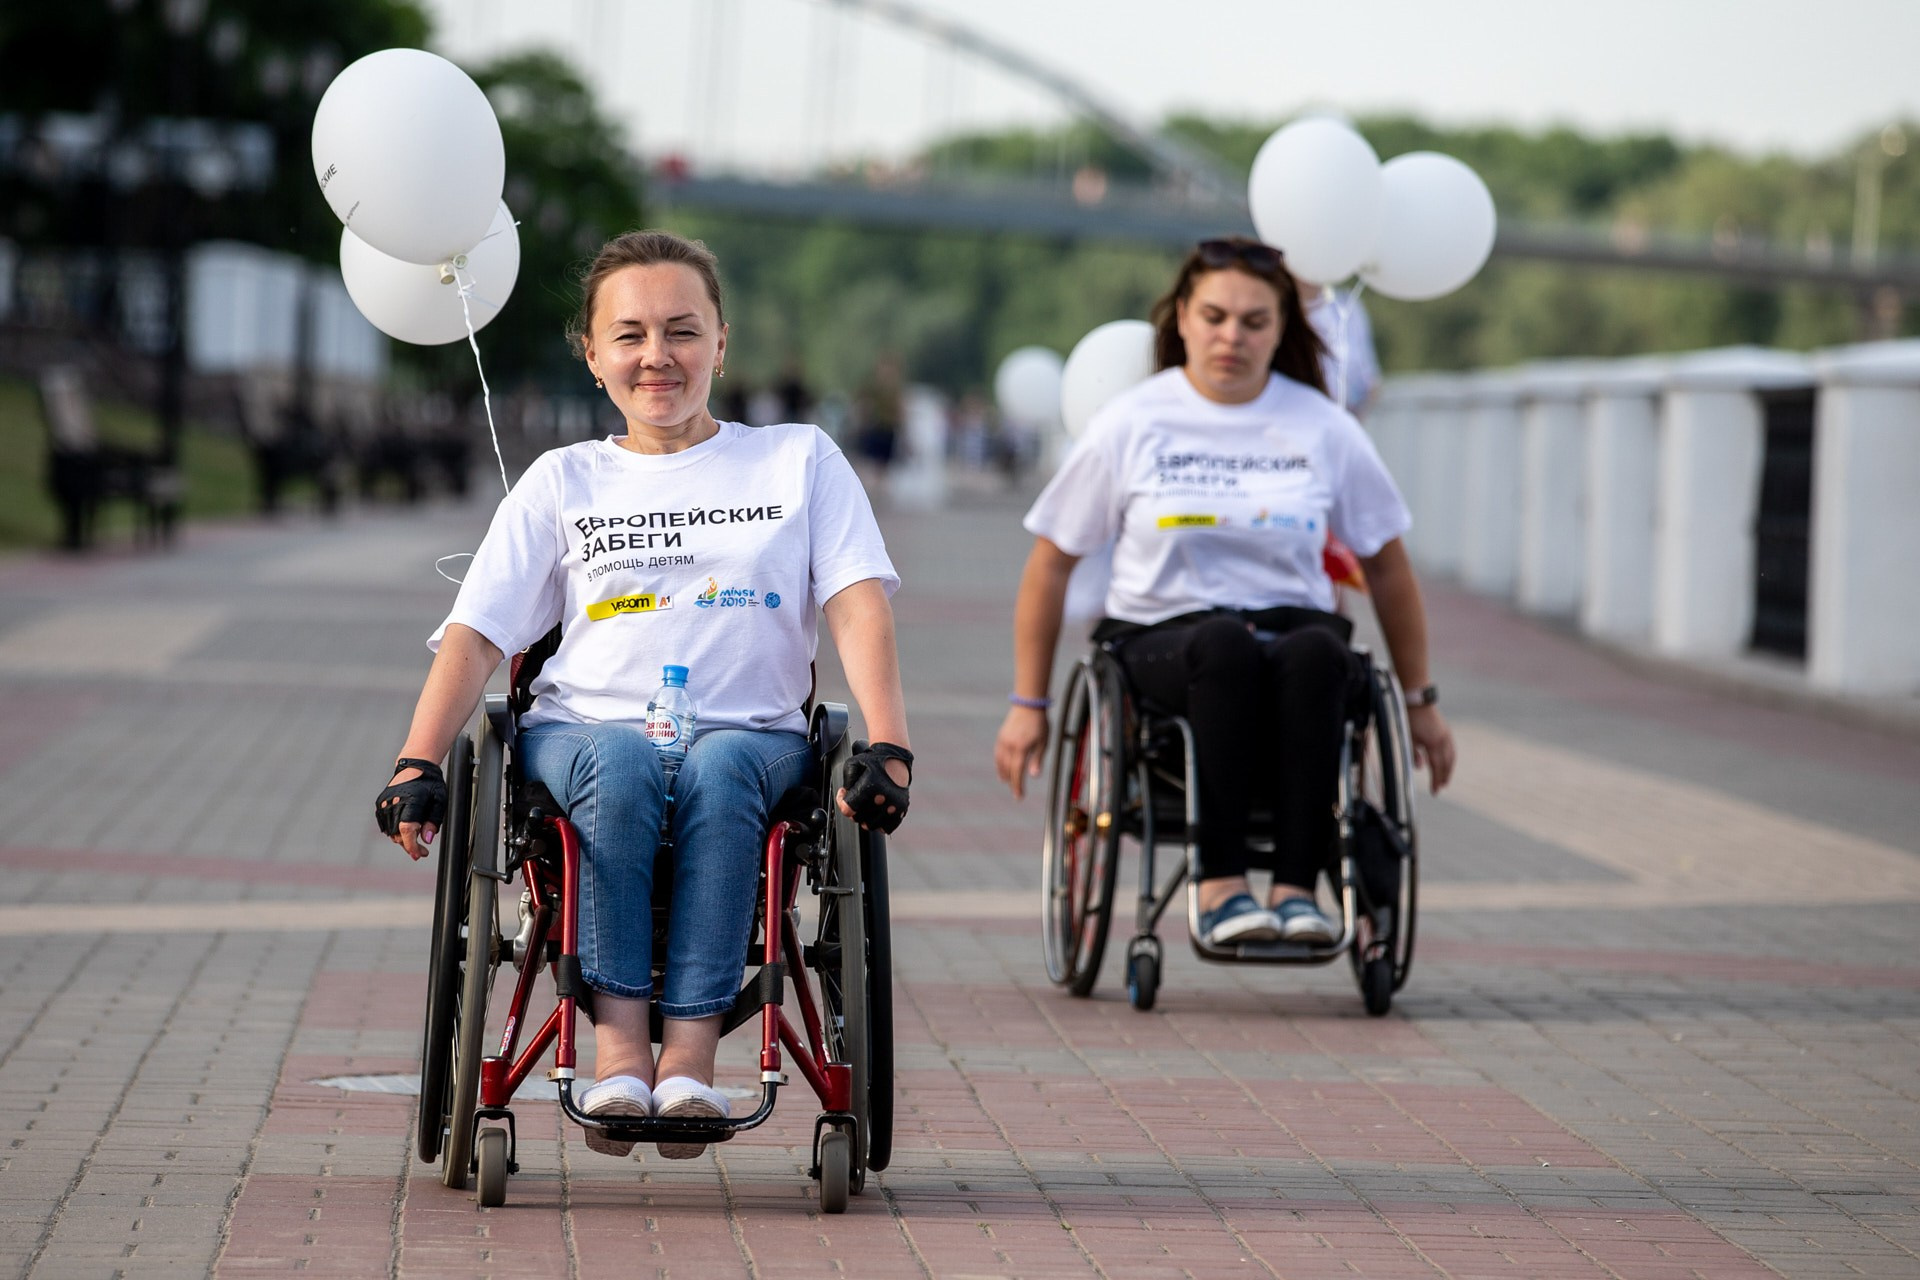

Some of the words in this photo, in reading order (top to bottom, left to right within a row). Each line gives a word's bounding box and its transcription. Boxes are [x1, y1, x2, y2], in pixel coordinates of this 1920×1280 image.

[321, 163, 337, 191] СКИЕ
[575, 505, 783, 540] ЕВРОПЕЙСКИЕ
[581, 532, 682, 562] ЗАБЕГИ
[592, 558, 644, 579] помощь
[648, 555, 694, 569] детям
[659, 595, 671, 607] A1
[720, 597, 747, 607] 2019
